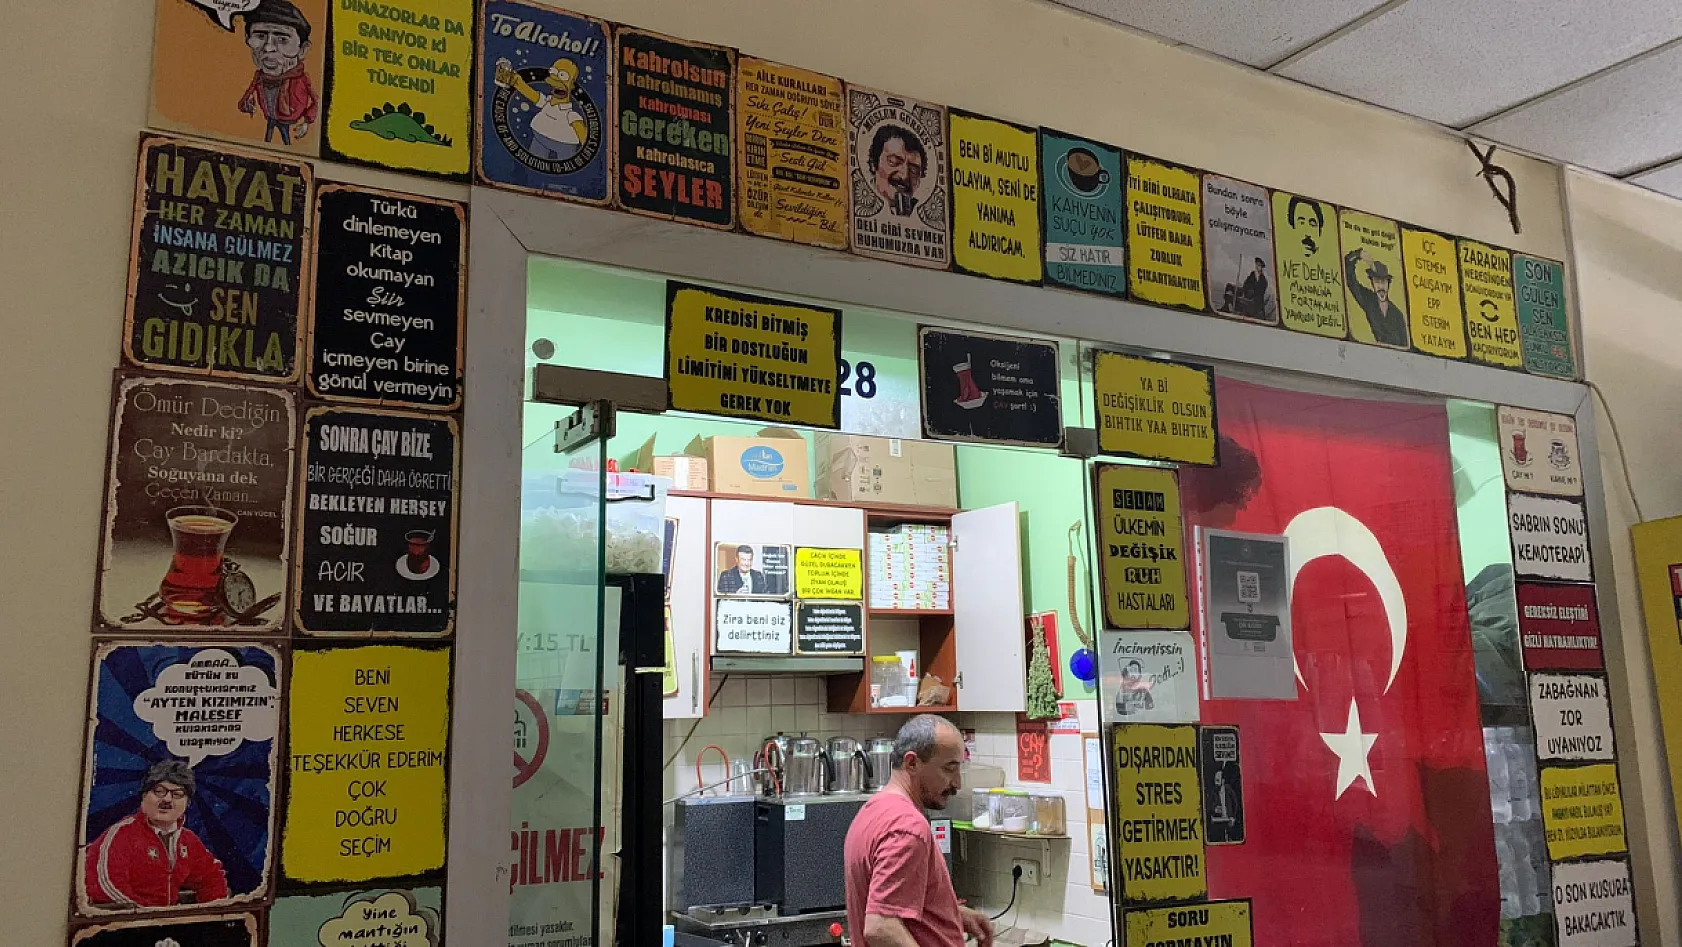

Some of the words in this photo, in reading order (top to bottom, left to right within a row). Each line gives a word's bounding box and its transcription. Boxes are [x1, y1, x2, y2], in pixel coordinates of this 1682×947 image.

[358, 22, 427, 49] SANIYOR
[432, 37, 446, 53] Kİ
[445, 19, 464, 36] DA
[491, 13, 521, 36] To
[514, 20, 599, 58] Alcohol!
[343, 40, 368, 59] BİR
[373, 48, 403, 66] TEK
[407, 55, 460, 77] ONLAR
[622, 46, 726, 89] Kahrolsun
[366, 68, 435, 95] TÜKENDİ
[756, 68, 776, 85] AİLE
[778, 75, 828, 96] KURALLARI
[760, 85, 785, 99] ZAMAN
[621, 109, 729, 157] Gereken
[959, 139, 980, 160] BEN
[982, 142, 994, 164] Bİ
[996, 151, 1029, 172] MUTLU
[156, 152, 300, 214] HAYAT
[623, 162, 723, 209] ŞEYLER
[953, 169, 995, 196] OLAYIM,
[998, 175, 1021, 201] SENİ
[1023, 184, 1036, 201] DE
[1207, 183, 1238, 201] Bundan
[1241, 191, 1264, 207] sonra
[159, 200, 204, 226] HER
[215, 209, 294, 239] ZAMAN
[370, 199, 417, 219] Türkü
[977, 202, 1015, 226] YANIMA
[1051, 194, 1117, 225] KAHVENİN
[1224, 203, 1248, 219] böyle
[342, 215, 441, 245] dinlemeyen
[856, 218, 878, 231] DELİ
[905, 227, 944, 245] SEVMEK
[1052, 215, 1086, 237] SUÇU
[1136, 221, 1167, 242] LÜTFEN
[1168, 228, 1193, 248] BANA
[154, 222, 218, 252] İNSANA
[224, 235, 293, 263] GÜLMEZ
[370, 242, 413, 265] Kitap
[924, 243, 944, 259] VAR
[969, 230, 1026, 259] ALDIRICAM.
[1059, 246, 1077, 261] SİZ
[1080, 248, 1111, 264] HATIR
[1463, 247, 1509, 272] ZARARIN
[151, 249, 245, 284] AZICIK
[254, 263, 290, 293] DA
[346, 262, 434, 287] okumayan
[1057, 264, 1117, 290] BİLMEDİNİZ
[1525, 260, 1551, 282] SON
[210, 287, 258, 326] SEN
[1521, 283, 1558, 308] GÜLEN
[343, 308, 434, 331] sevmeyen
[705, 306, 757, 329] KREDİSİ
[762, 313, 808, 341] BİTMİŞ
[1532, 308, 1553, 325] SEN
[142, 317, 284, 371] GIDIKLA
[370, 332, 405, 354] Çay
[1470, 321, 1491, 339] BEN
[1495, 327, 1516, 345] HEP
[705, 331, 727, 352] BİR
[731, 338, 808, 364] DOSTLUĞUN
[322, 348, 398, 372] içmeyen
[404, 355, 449, 376] birine
[318, 373, 366, 390] gönül
[373, 379, 452, 400] vermeyin
[677, 355, 737, 381] LİMİTİNİ
[741, 366, 831, 394] YÜKSELTMEYE
[1140, 377, 1153, 391] YA
[1158, 377, 1168, 392] Bİ
[133, 388, 193, 415] Ömür
[201, 397, 280, 428] Dediğin
[720, 392, 761, 411] GEREK
[765, 398, 791, 416] YOK
[1103, 392, 1164, 413] DEĞİŞİKLİK
[1172, 402, 1206, 418] OLSUN
[170, 421, 217, 438] Nedir
[220, 426, 243, 440] ki?
[1105, 415, 1143, 432] BIHTIK
[1147, 420, 1167, 435] YAA
[1171, 422, 1208, 439] BIHTIK
[133, 438, 174, 466] Çay
[320, 424, 370, 454] SONRA
[371, 428, 399, 460] ÇAY
[147, 465, 225, 483] Soğuyana
[230, 471, 258, 485] dek
[308, 461, 326, 483] BİR
[328, 464, 376, 490] GERÇEĞİ
[378, 469, 406, 488] DAHA
[309, 493, 385, 513] BEKLEYEN
[390, 497, 447, 518] HERŞEY
[1113, 489, 1165, 512] SELAM
[320, 523, 378, 546] SOĞUR
[1114, 514, 1165, 537] ÜLKEMİN
[1512, 513, 1551, 532] SABRIN
[1553, 517, 1585, 536] SONU
[1109, 543, 1177, 563] DEĞİŞİK
[1518, 543, 1585, 563] KEMOTERAPİ
[318, 561, 365, 582] ACIR
[1124, 567, 1162, 584] RUH
[313, 594, 334, 612] VE
[340, 594, 442, 614] BAYATLAR...
[1117, 592, 1175, 611] HASTALARI
[723, 614, 743, 625] Zira
[746, 614, 768, 625] beni
[771, 616, 785, 625] siz
[728, 630, 780, 641] delirttiniz
[355, 667, 391, 685] BENİ
[173, 710, 243, 722] MALESEF
[344, 696, 399, 713] SEVEN
[1559, 709, 1582, 726] ZOR
[333, 724, 405, 741] HERKESE
[1547, 735, 1603, 755] UYANIYOZ
[292, 749, 381, 774] TEŞEKKÜR
[387, 748, 442, 769] EDERİM
[1119, 746, 1195, 773] DIŞARIDAN
[348, 780, 387, 801] ÇOK
[1136, 782, 1183, 806] STRES
[335, 805, 397, 828] DOĞRU
[1122, 812, 1199, 843] GETİRMEK
[339, 833, 391, 857] SEÇİM
[1125, 855, 1200, 881] YASAKTIR!
[1555, 885, 1562, 905] O
[1566, 883, 1587, 904] SON
[1590, 877, 1630, 901] KUSURA
[338, 921, 418, 940] mantığın
[1168, 909, 1209, 929] SORU
[1565, 910, 1626, 936] BAKACAKTIK
